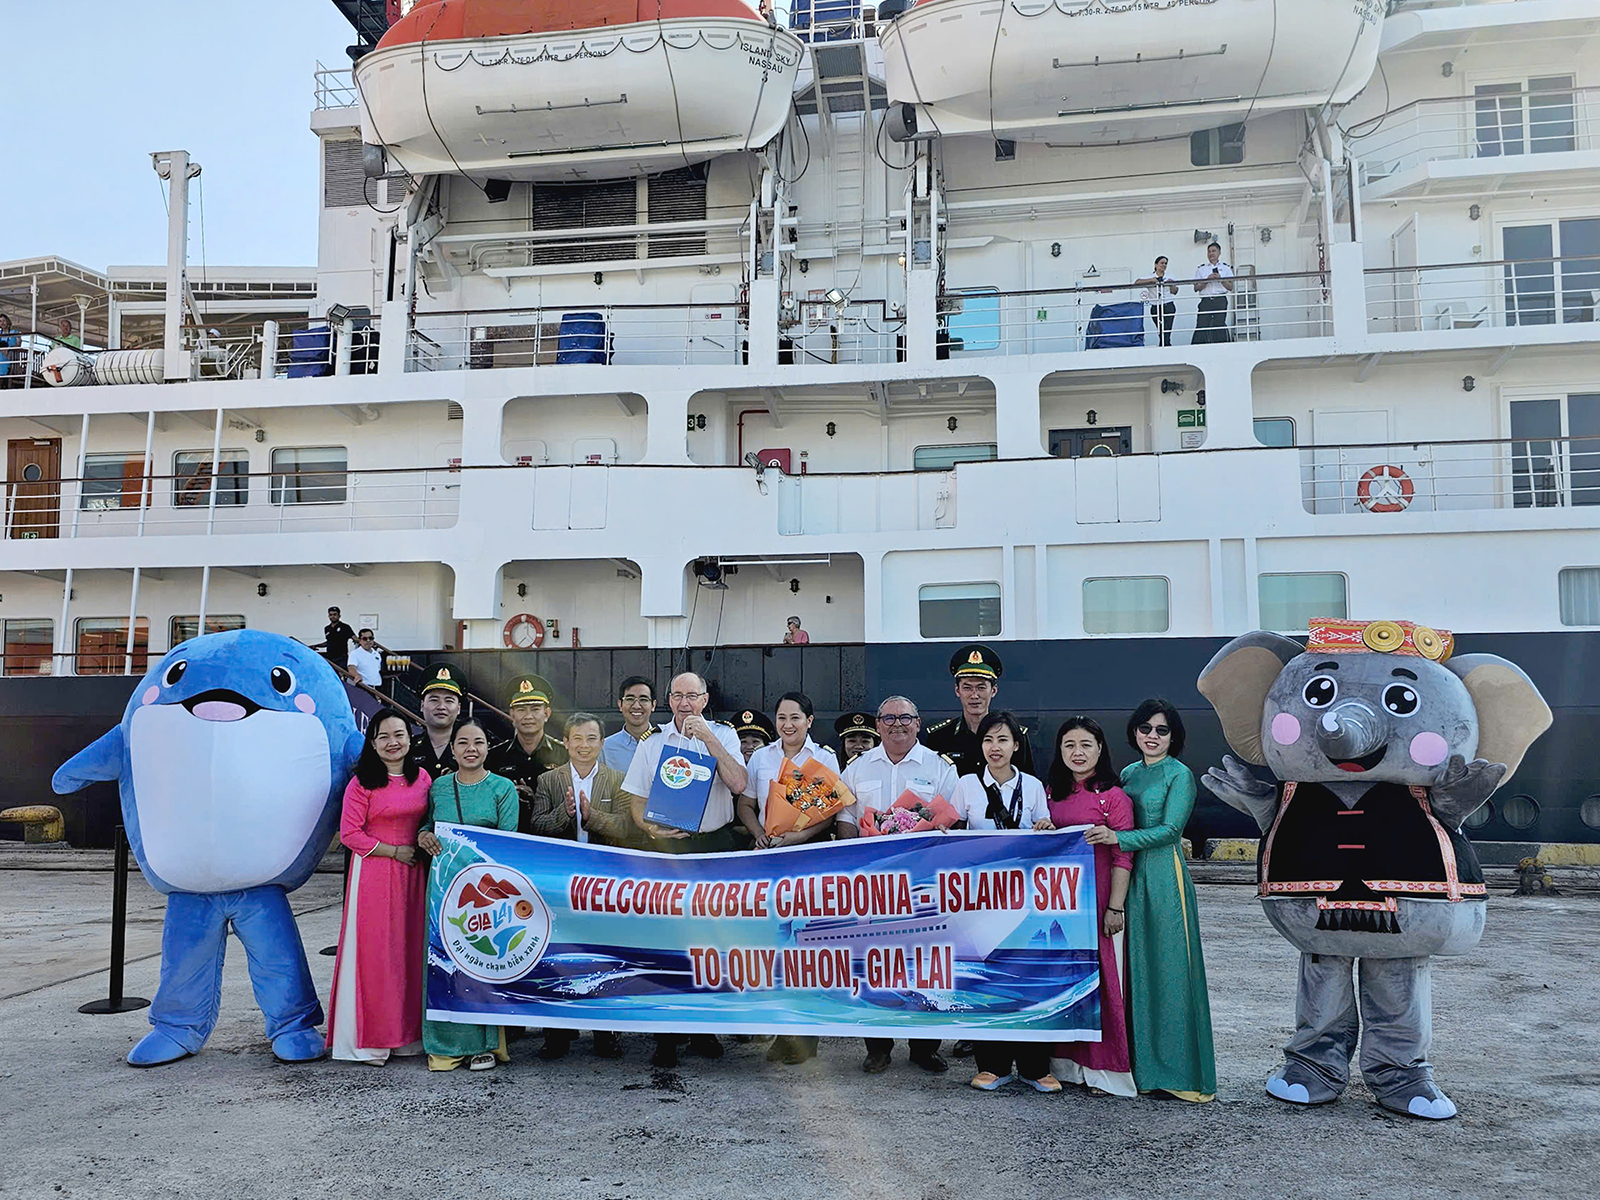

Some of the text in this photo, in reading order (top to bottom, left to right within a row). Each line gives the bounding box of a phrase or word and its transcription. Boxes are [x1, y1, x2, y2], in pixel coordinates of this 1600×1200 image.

[740, 43, 791, 65] ISLAND SKY
[749, 56, 783, 74] NASSAU
[570, 875, 688, 916] WELCOME
[691, 881, 770, 918] NOBLE
[775, 873, 913, 918] CALEDONIA
[939, 869, 1026, 914] ISLAND
[1033, 866, 1081, 912] SKY
[467, 901, 512, 932] GIA LAI
[464, 953, 484, 968] ngàn
[485, 962, 507, 972] chạm
[524, 935, 540, 957] xanh
[689, 946, 952, 996] TO QUY NHON, GIA LAI
